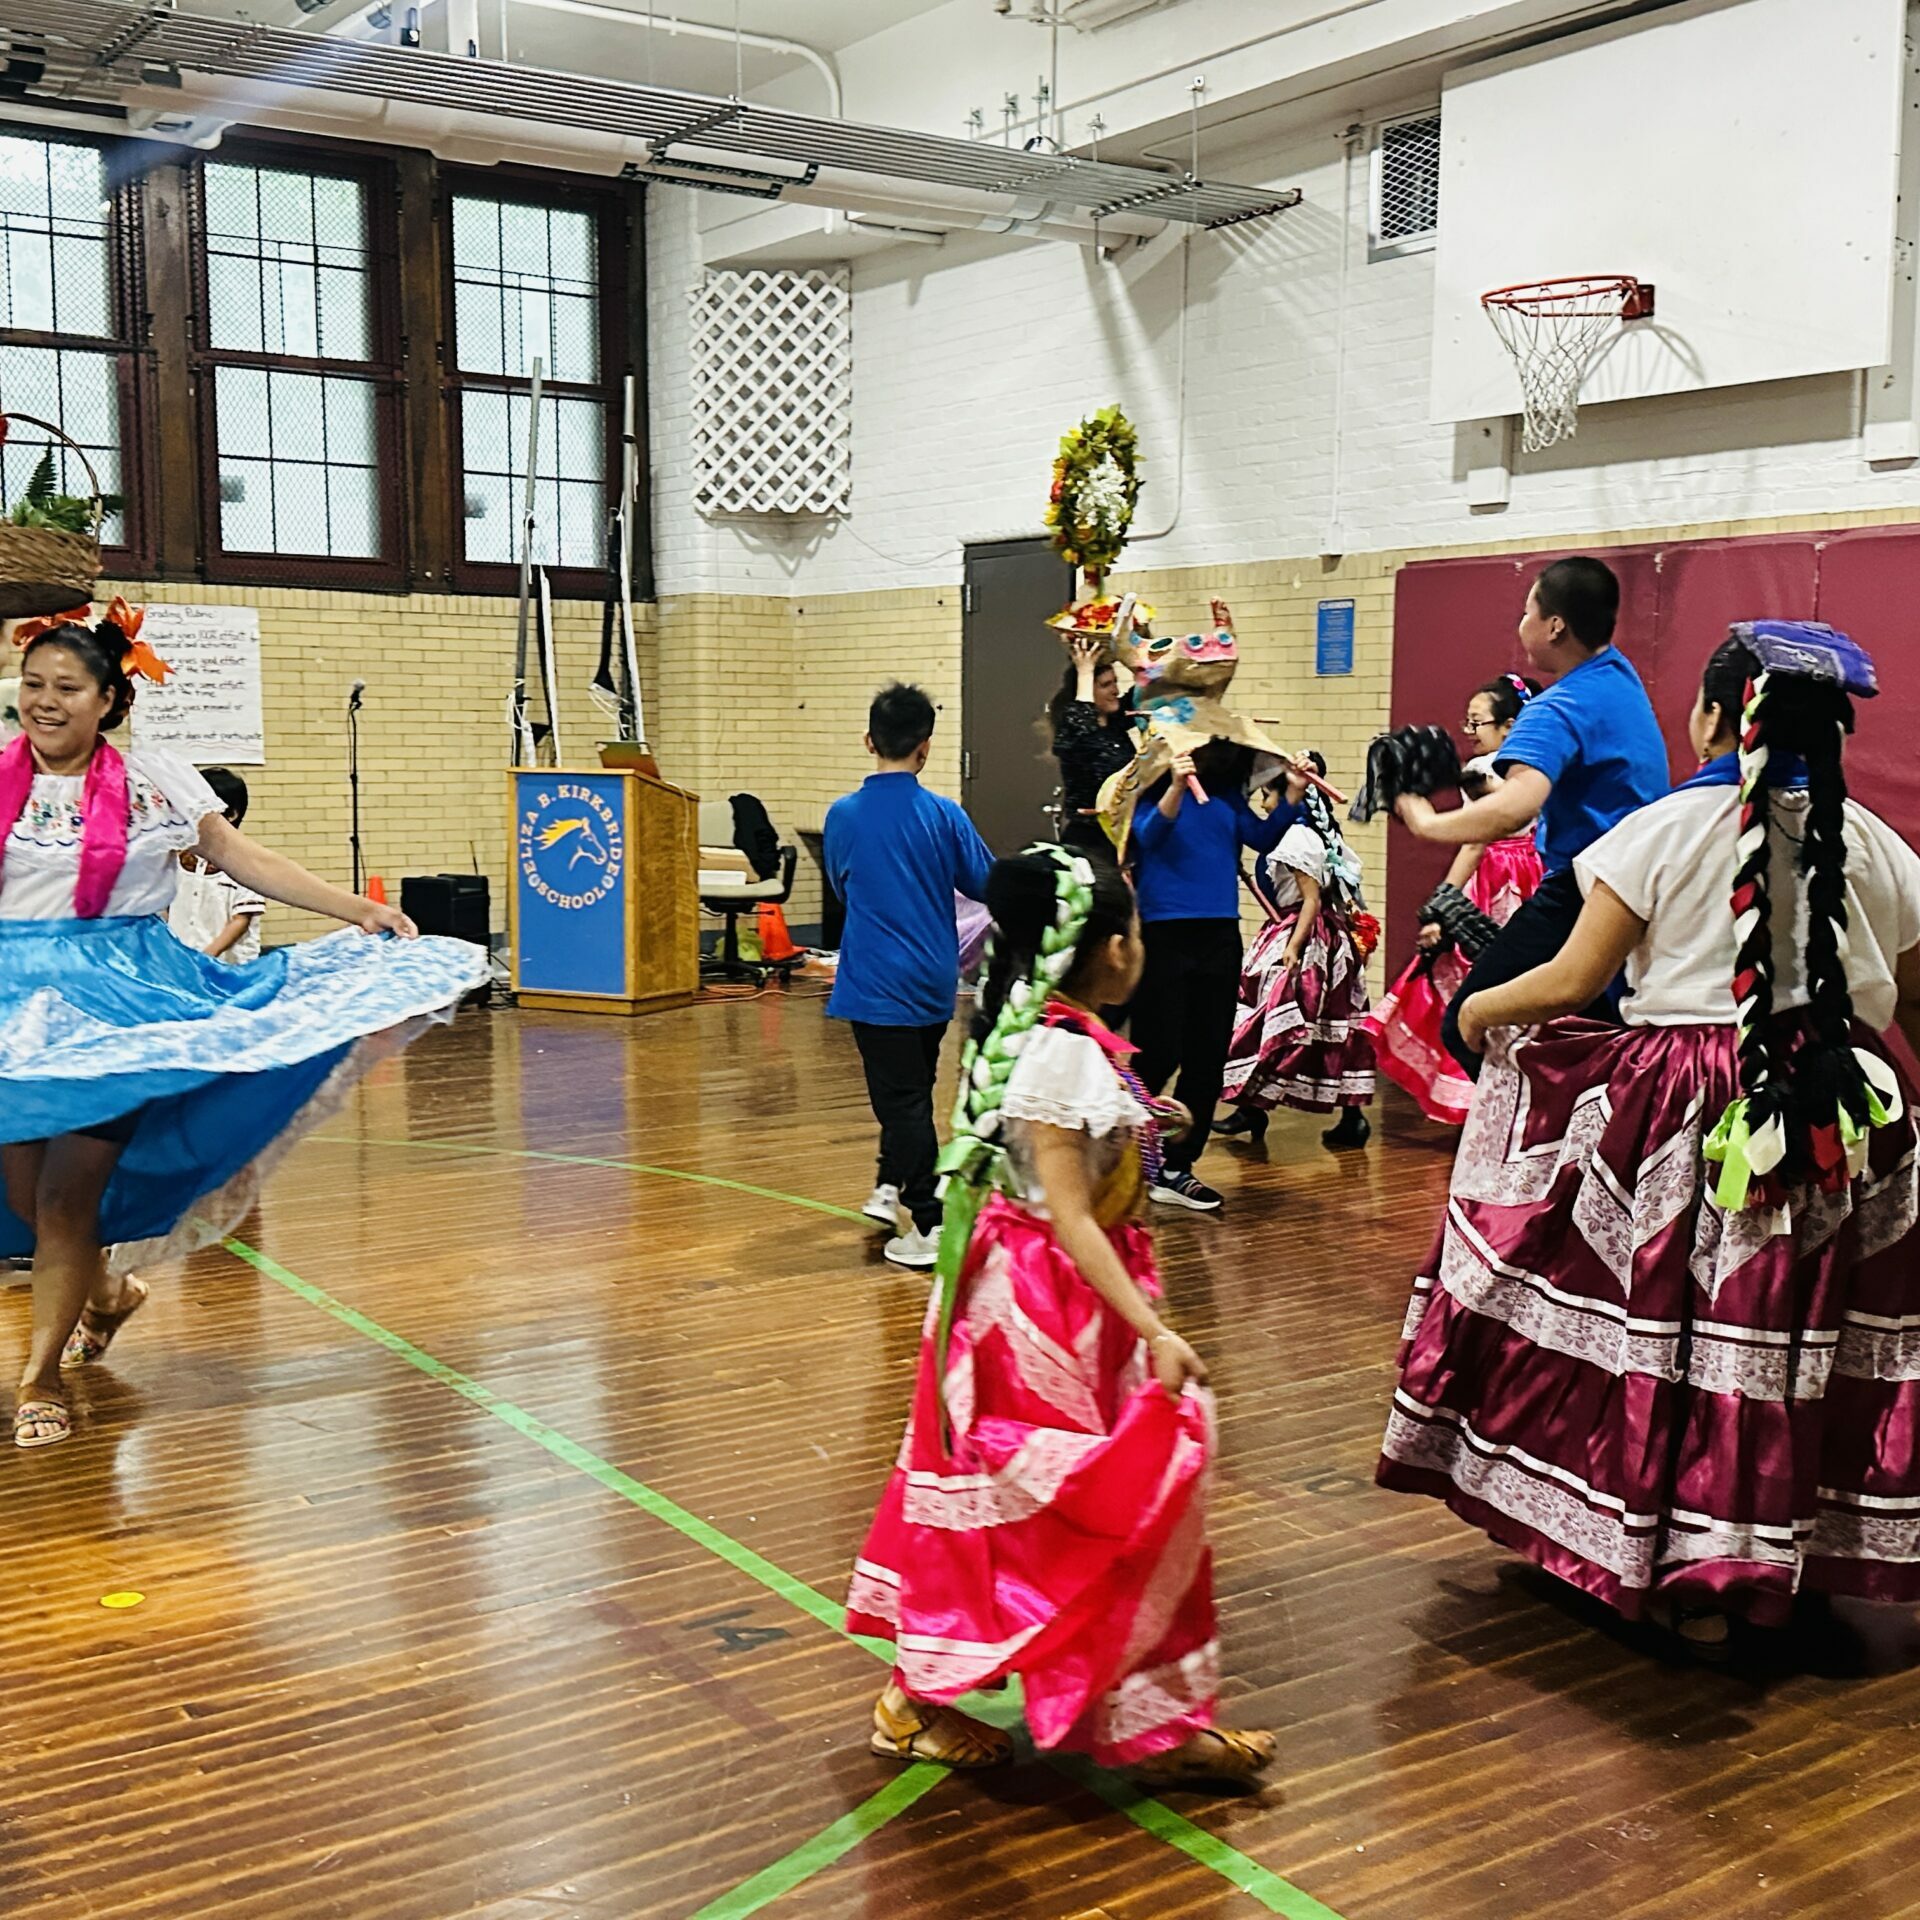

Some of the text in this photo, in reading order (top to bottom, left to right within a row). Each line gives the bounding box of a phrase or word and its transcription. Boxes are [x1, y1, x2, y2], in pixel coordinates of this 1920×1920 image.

[520, 784, 623, 876] ELIZA B. KIRKBRIDE
[535, 882, 607, 910] SCHOOL
